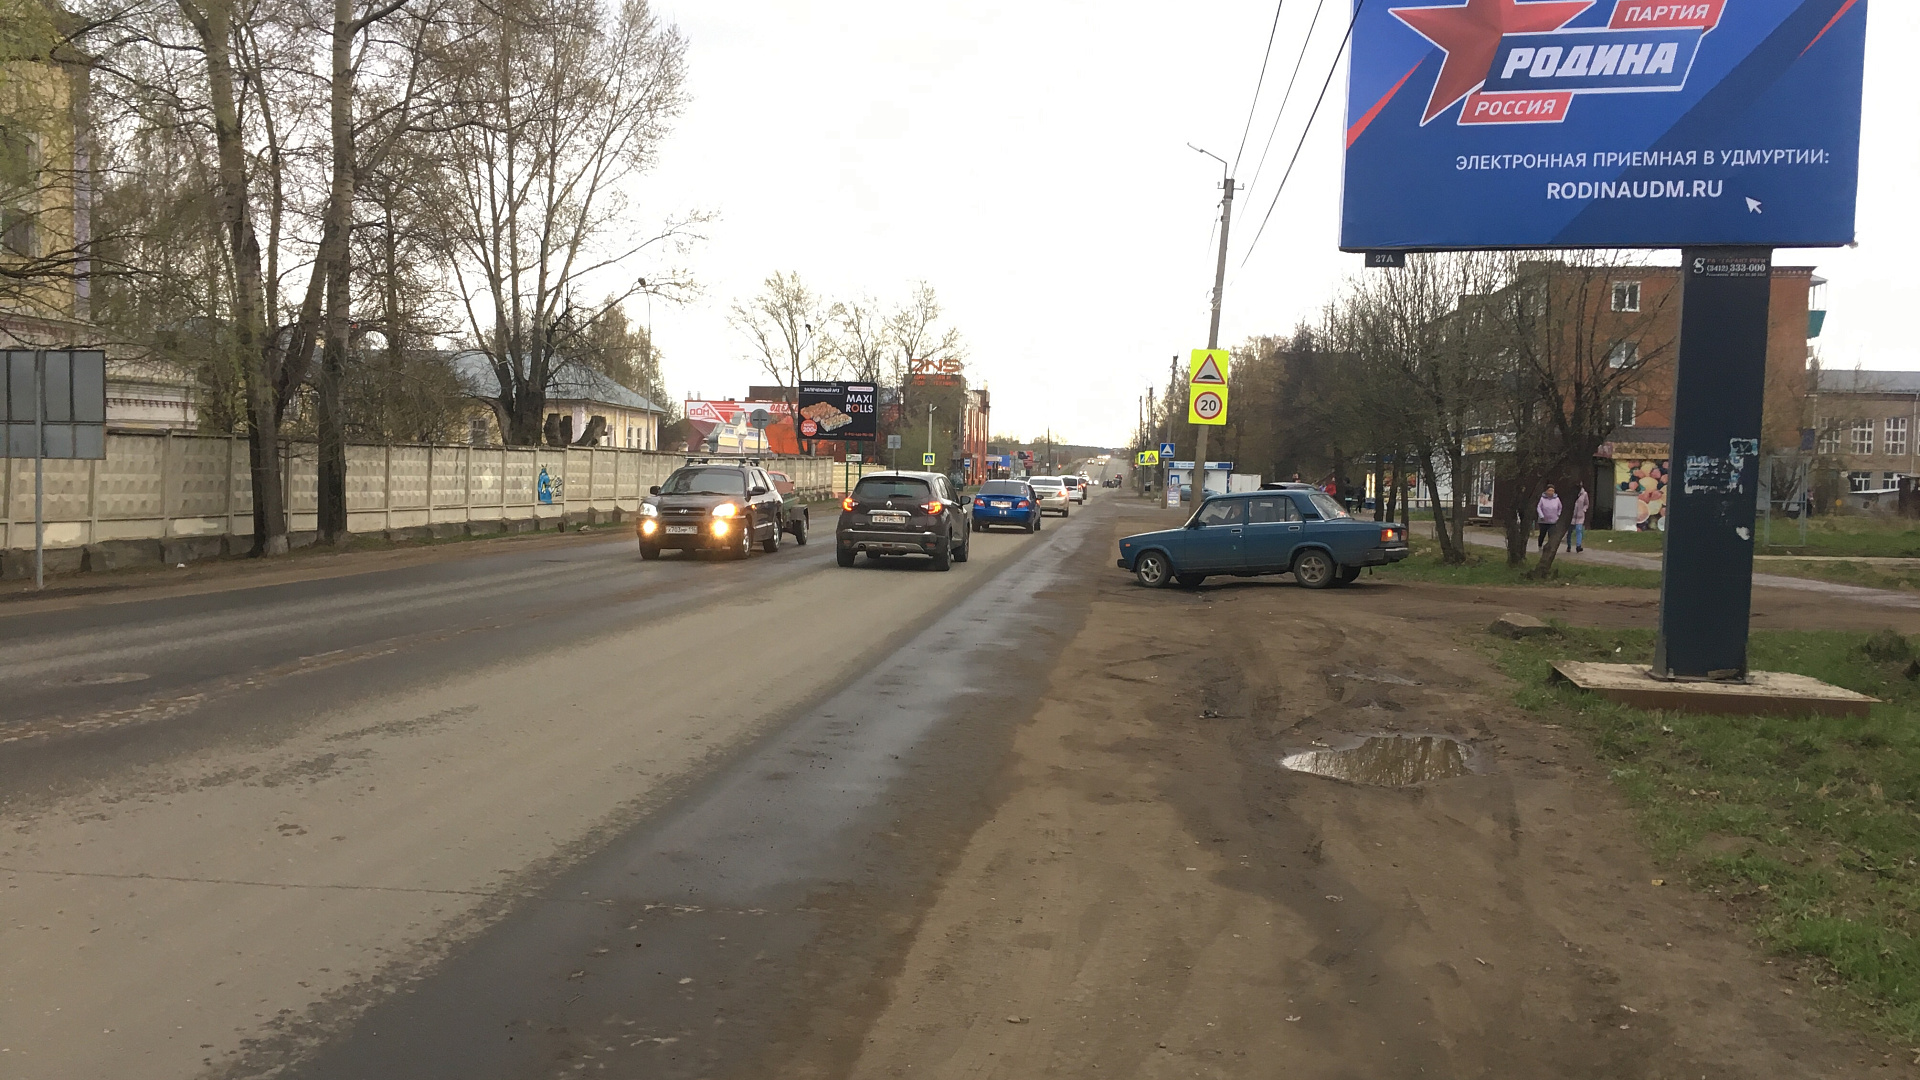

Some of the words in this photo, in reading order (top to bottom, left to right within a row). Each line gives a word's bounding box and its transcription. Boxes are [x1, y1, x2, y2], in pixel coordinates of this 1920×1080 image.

[1624, 4, 1710, 22] ПАРТИЯ
[1501, 42, 1679, 79] РОДИНА
[1474, 99, 1557, 117] РОССИЯ
[1455, 152, 1587, 171] ЭЛЕКТРОННАЯ
[1593, 150, 1697, 168] ПРИЕМНАЯ
[1703, 150, 1716, 166] В
[1720, 148, 1830, 167] УДМУРТИИ:
[1546, 179, 1724, 200] RODINAUDM.RU
[1706, 264, 1729, 272] (3412)
[1729, 263, 1766, 272] 333-000
[846, 394, 873, 403] MAXI
[1200, 399, 1217, 411] 20
[845, 403, 874, 413] ROLLS
